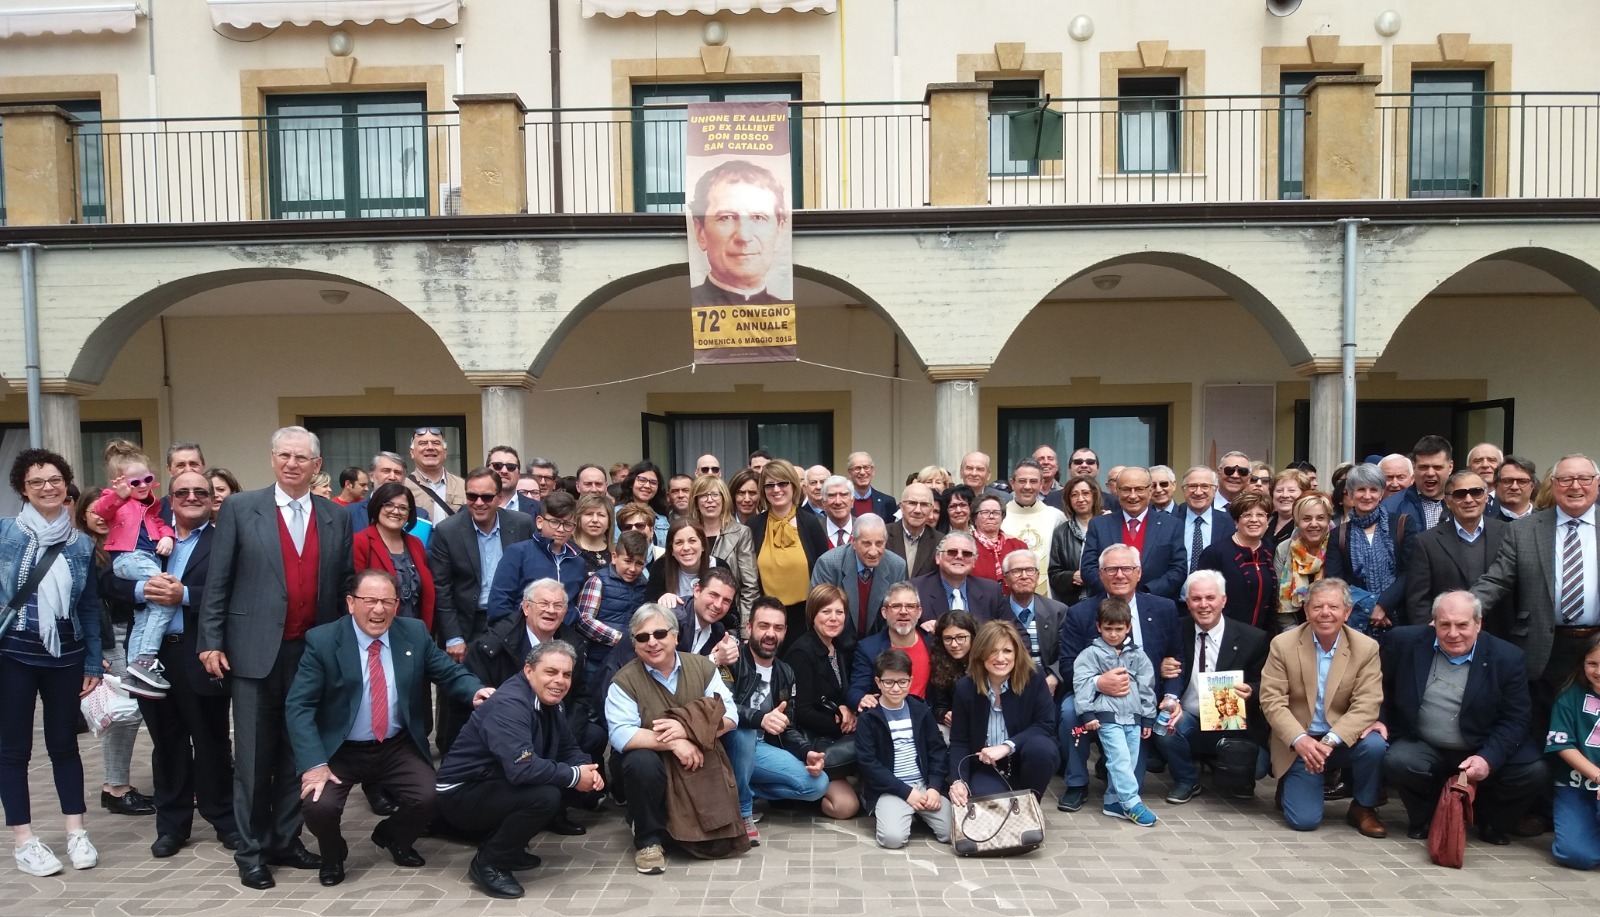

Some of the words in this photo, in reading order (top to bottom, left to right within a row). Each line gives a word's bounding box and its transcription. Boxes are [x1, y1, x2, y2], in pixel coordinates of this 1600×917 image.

[691, 115, 729, 123] UNIONE
[733, 114, 745, 122] EX
[749, 114, 786, 122] ALLIEVI
[702, 125, 715, 133] ED
[735, 124, 775, 132] ALLIEVE
[734, 133, 769, 141] BOSCO
[704, 142, 723, 151] SAN
[728, 142, 773, 150] CATALDO
[732, 307, 790, 318] CONVEGNO
[736, 321, 788, 331] ANNUALE
[698, 338, 736, 346] DOMENICA
